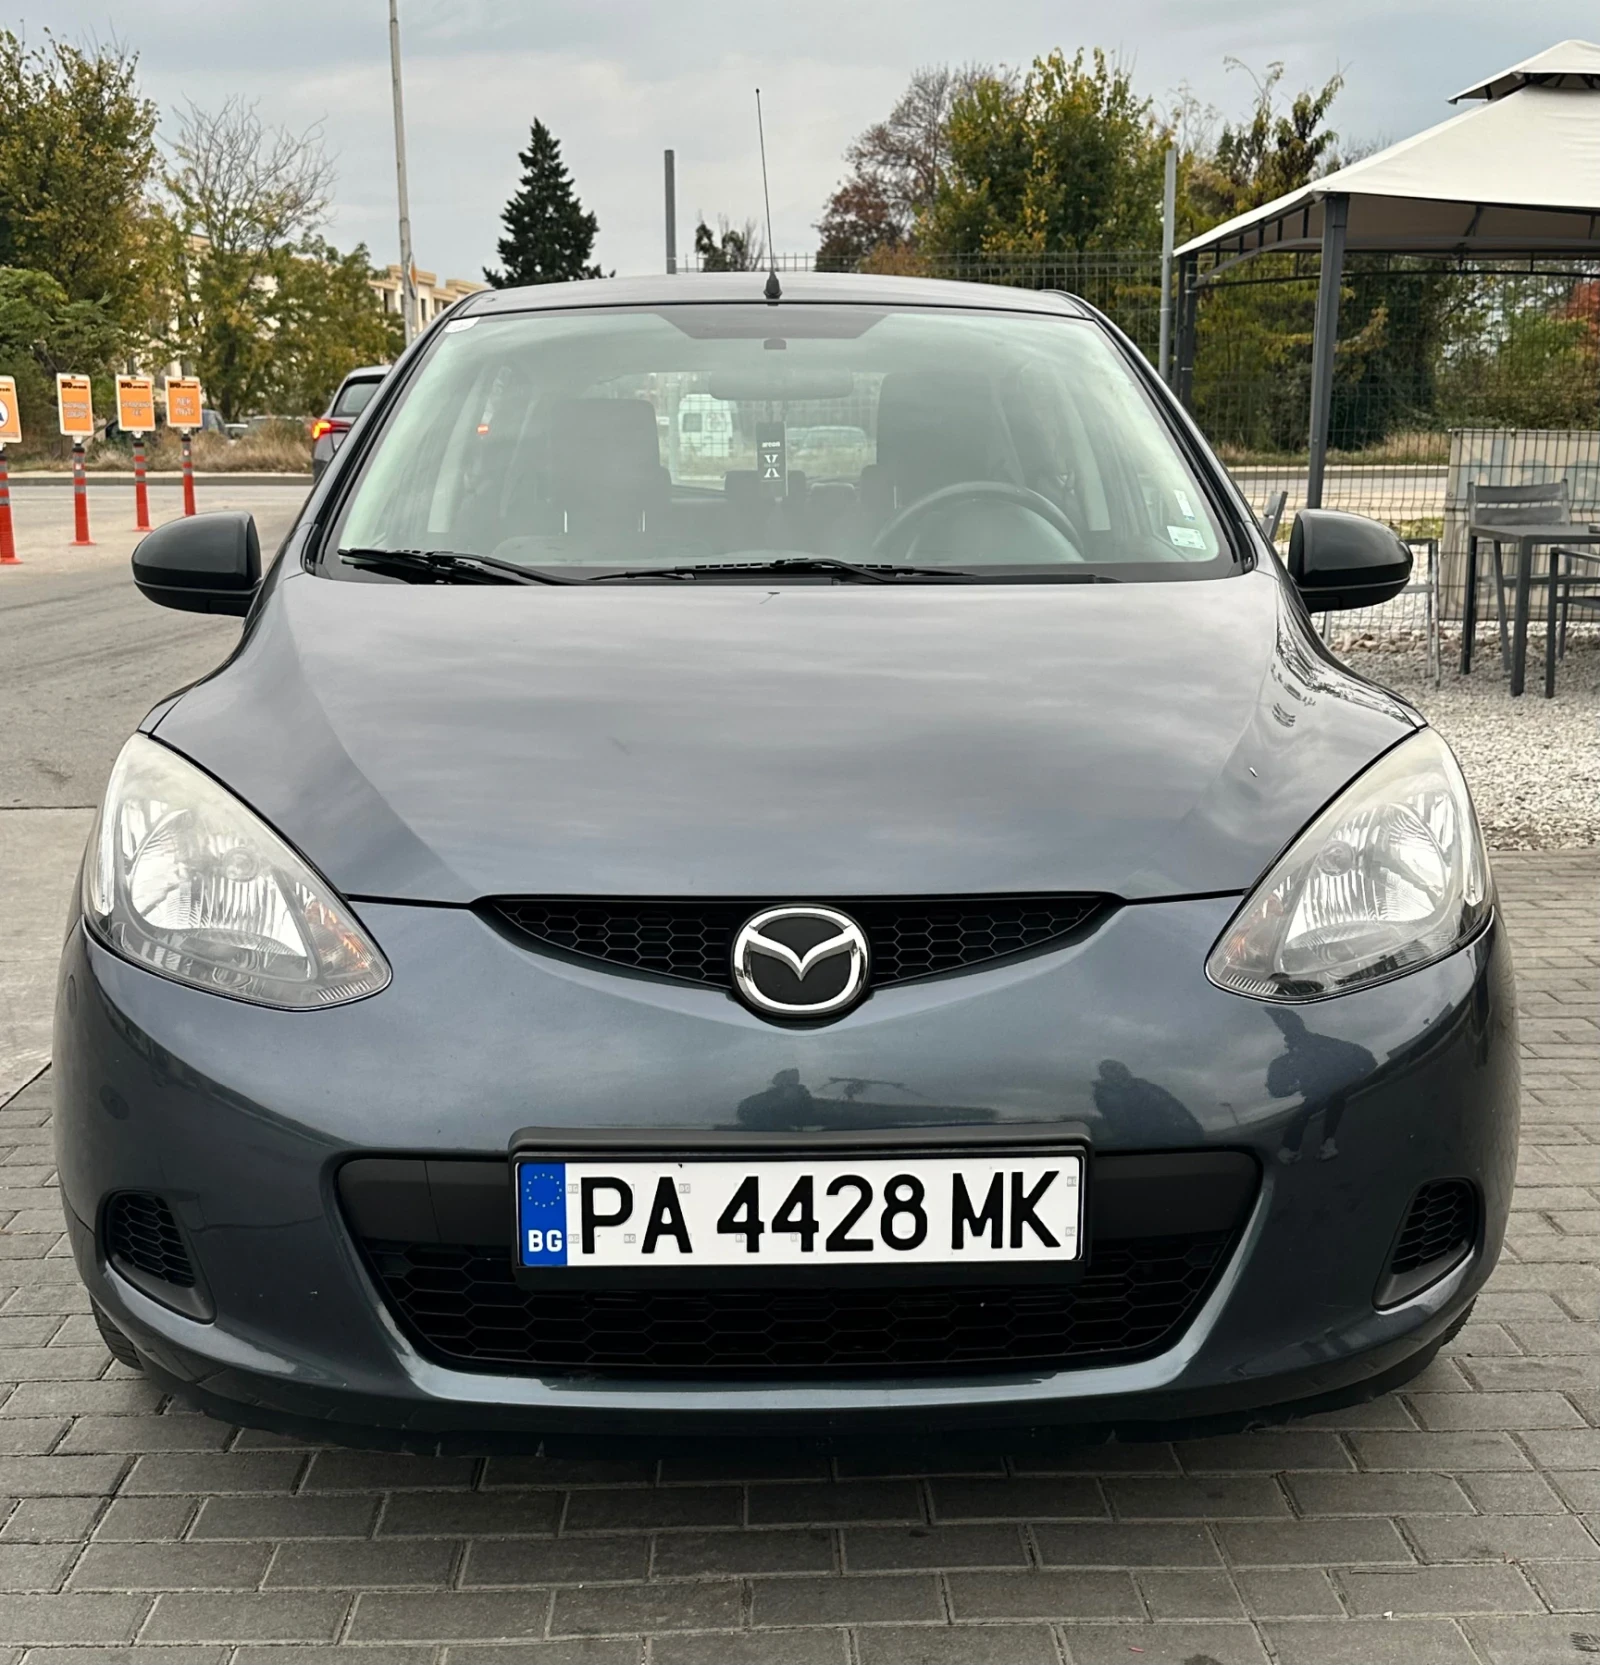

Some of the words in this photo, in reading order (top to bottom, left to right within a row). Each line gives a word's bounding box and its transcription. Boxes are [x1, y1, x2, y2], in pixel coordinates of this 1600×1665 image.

[581, 1177, 692, 1254] PA
[717, 1174, 927, 1252] 4428
[952, 1171, 1060, 1249] MK
[529, 1230, 562, 1251] BG
